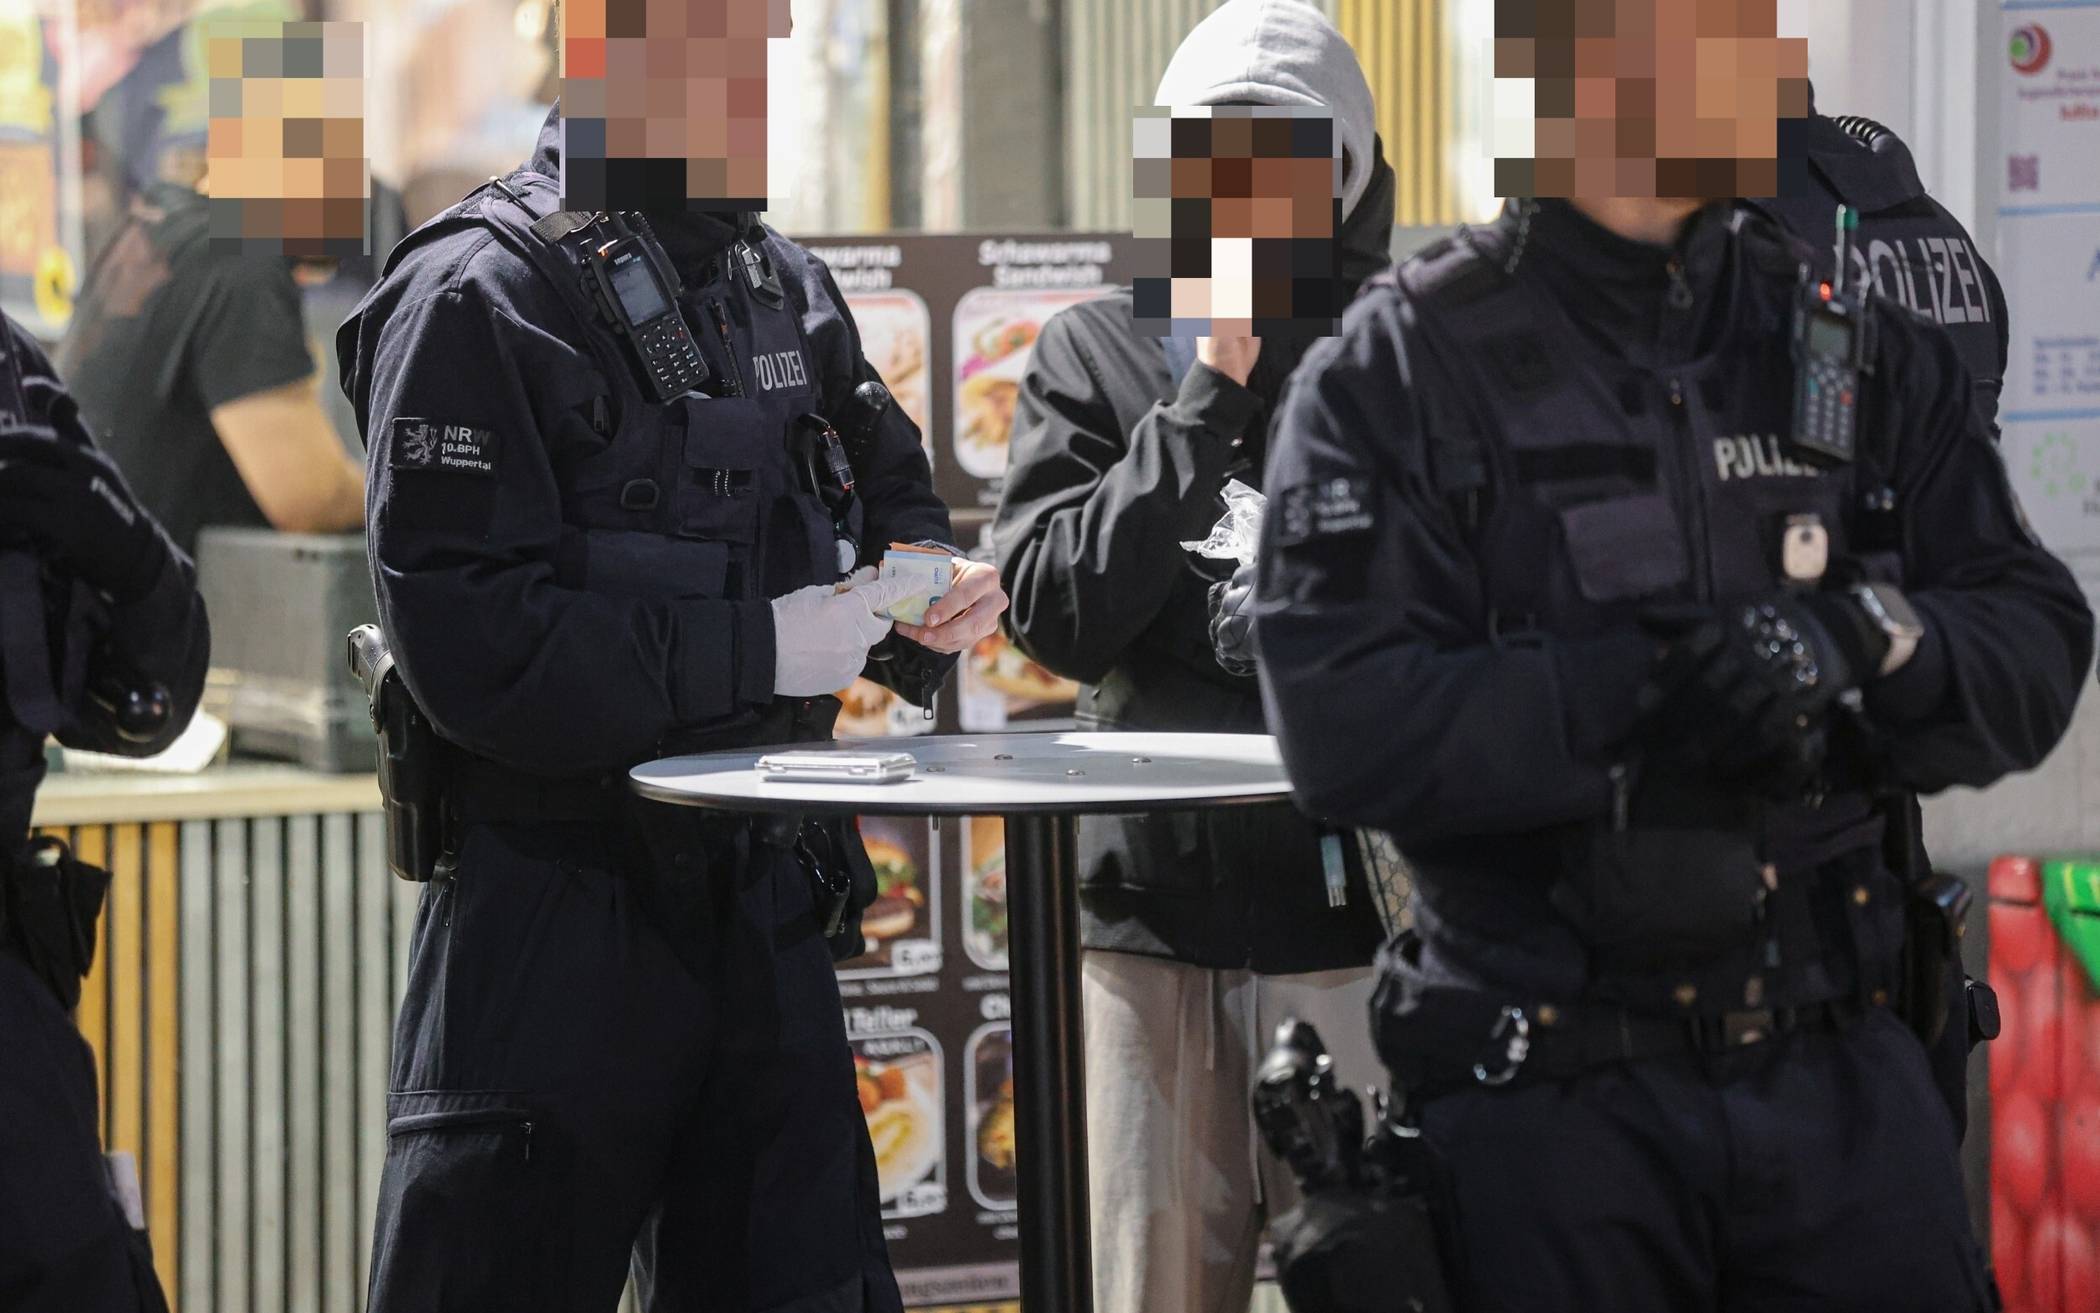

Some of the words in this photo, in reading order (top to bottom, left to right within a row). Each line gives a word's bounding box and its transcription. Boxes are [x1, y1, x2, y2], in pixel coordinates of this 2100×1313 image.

[444, 425, 490, 446] NRW
[441, 442, 481, 455] 10.BPH
[441, 456, 492, 470] Wuppertal
